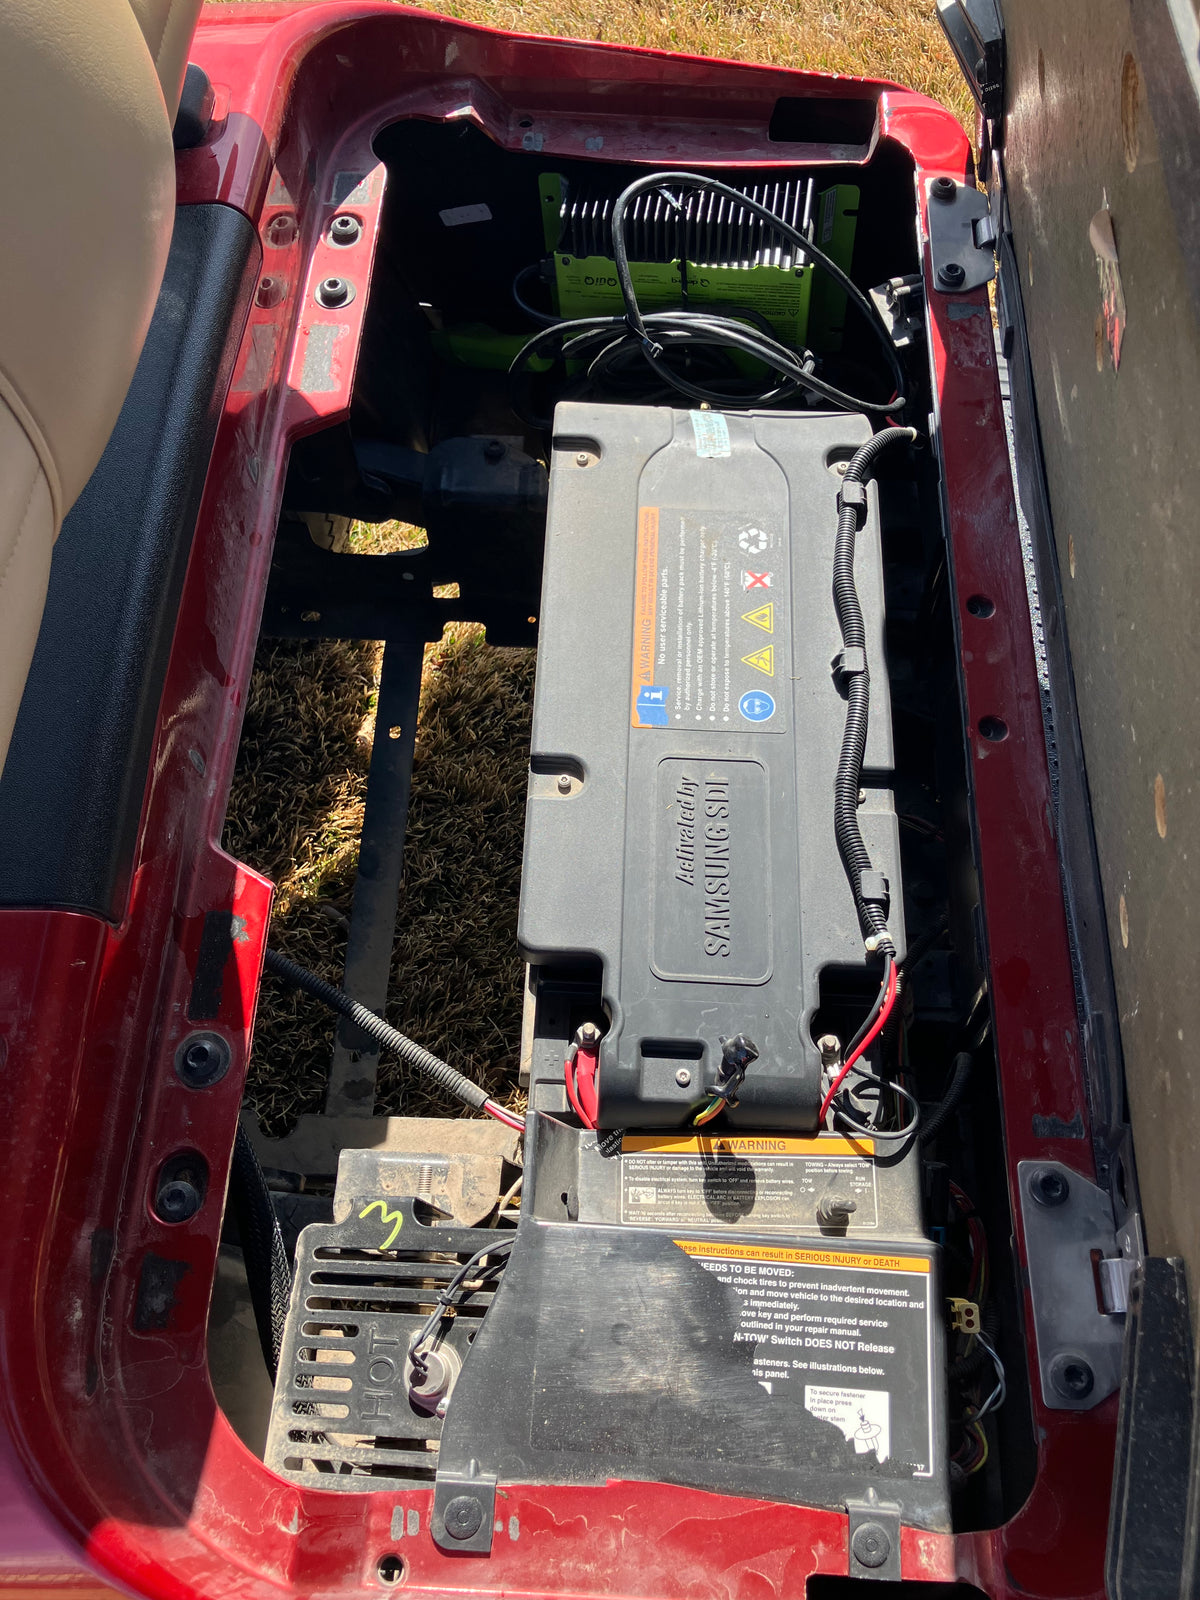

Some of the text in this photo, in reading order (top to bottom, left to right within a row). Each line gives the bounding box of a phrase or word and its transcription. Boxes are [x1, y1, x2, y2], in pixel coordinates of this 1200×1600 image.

[659, 566, 669, 587] parts.
[677, 571, 685, 585] pack
[697, 562, 706, 583] battery
[676, 587, 685, 607] battery
[658, 588, 667, 632] serviceable
[710, 592, 718, 632] temperatures
[696, 618, 705, 647] approved
[723, 618, 731, 658] temperatures
[640, 618, 651, 668] WARNING
[684, 636, 692, 667] personnel
[709, 640, 717, 664] operate
[657, 653, 665, 664] No
[674, 684, 683, 710] Service,
[683, 702, 691, 710] by
[695, 688, 704, 710] Charge
[709, 702, 715, 711] Do
[722, 702, 729, 712] Do
[674, 776, 700, 886] Activated by
[704, 776, 731, 958] SAMSUNG SDI
[728, 1139, 786, 1150] WARNING
[698, 1246, 743, 1256] instructions
[761, 1250, 783, 1259] result
[785, 1252, 792, 1260] in
[794, 1252, 830, 1262] SERIOUS
[832, 1255, 860, 1264] INJURY
[873, 1258, 900, 1267] DEATH
[729, 1264, 742, 1273] TO
[743, 1265, 756, 1274] BE
[758, 1266, 794, 1277] MOVED:
[716, 1275, 910, 1296] and chock tires to prevent inadvertent movement.
[749, 1288, 764, 1296] and
[789, 1291, 818, 1300] vehicle
[819, 1293, 828, 1301] to
[829, 1294, 842, 1302] the
[844, 1295, 873, 1304] desired
[875, 1297, 907, 1307] location
[908, 1299, 924, 1308] and
[749, 1299, 800, 1311] immediately.
[740, 1320, 861, 1336] outlined in your repair manual.
[757, 1310, 771, 1320] key
[773, 1311, 788, 1320] and
[790, 1313, 821, 1323] perform
[823, 1315, 856, 1326] required
[858, 1317, 888, 1327] service
[770, 1335, 802, 1347] Switch
[804, 1338, 832, 1349] DOES
[833, 1340, 855, 1350] NOT
[857, 1342, 894, 1354] Release
[360, 1327, 399, 1422] HOT
[764, 1369, 789, 1380] panel.
[792, 1360, 808, 1369] See
[809, 1361, 857, 1372] illustrations
[858, 1364, 885, 1374] below.
[816, 1397, 833, 1405] place
[840, 1390, 865, 1398] fastener
